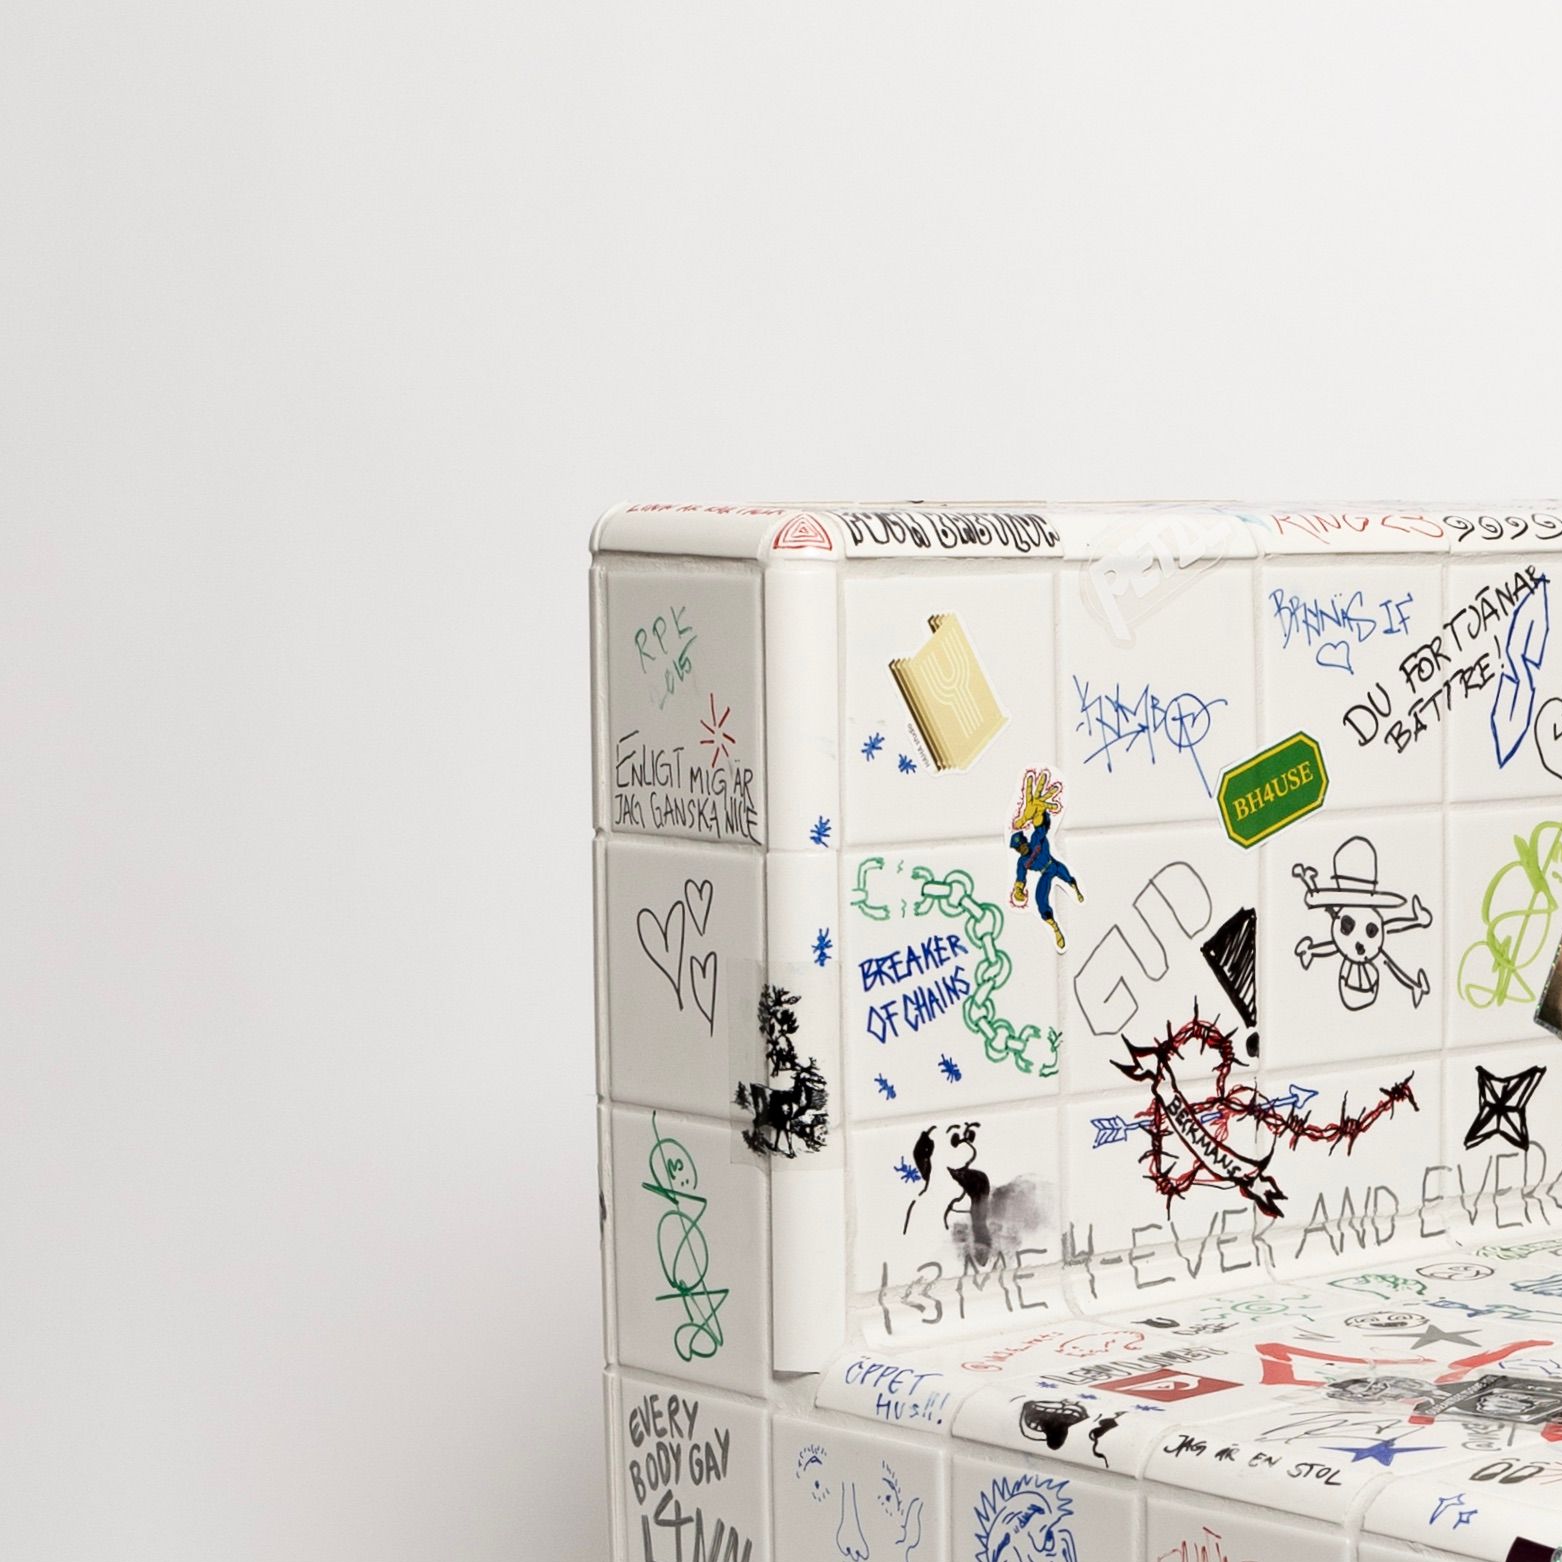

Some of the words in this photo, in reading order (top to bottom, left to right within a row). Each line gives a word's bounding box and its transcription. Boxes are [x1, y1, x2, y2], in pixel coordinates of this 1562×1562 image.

[1342, 682, 1394, 747] DU
[690, 766, 727, 797] MIG
[1231, 761, 1315, 822] BH4USE
[615, 794, 646, 828] JAG
[650, 791, 721, 839] GANSKA
[858, 933, 968, 993] BREAKER
[866, 1003, 900, 1044] OF
[902, 967, 971, 1034] CHAINS
[1294, 1186, 1400, 1260] AND
[628, 1393, 699, 1449] EVERY
[629, 1441, 681, 1505] BODY
[688, 1427, 730, 1487] GAY
[1163, 1434, 1207, 1458] JAG
[1214, 1441, 1243, 1463] ÄR
[1248, 1452, 1282, 1469] EN
[1287, 1462, 1342, 1487] STOL
